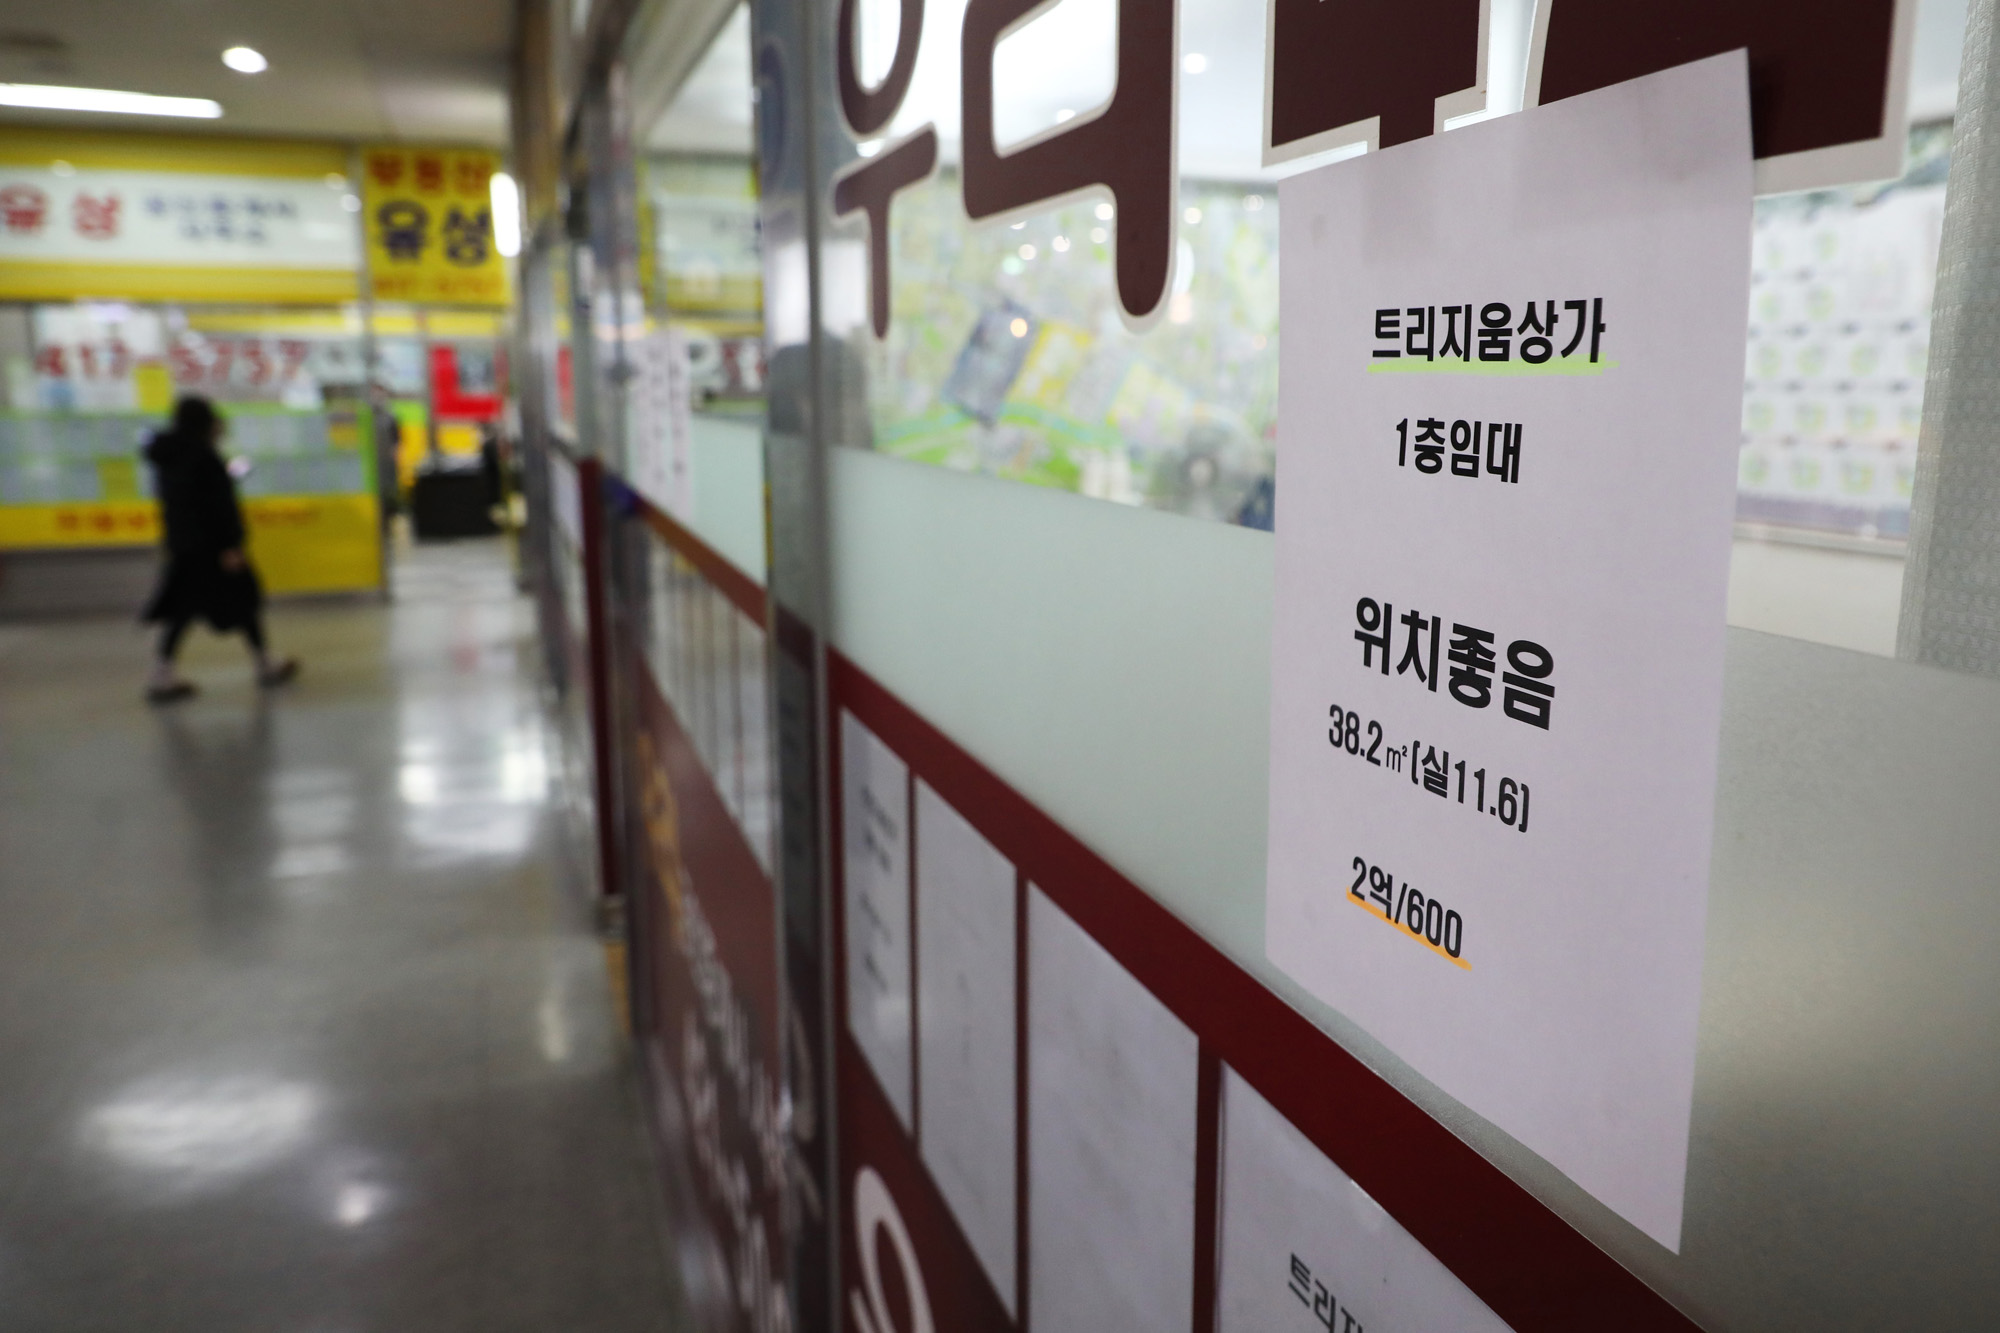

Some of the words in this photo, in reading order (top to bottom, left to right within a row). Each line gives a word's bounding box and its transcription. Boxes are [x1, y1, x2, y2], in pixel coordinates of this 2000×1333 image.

[1372, 297, 1606, 364] 트리지움상가
[1396, 417, 1523, 484] 1층임대
[1354, 597, 1556, 731] 위치좋음
[1351, 856, 1463, 959] 2억/600
[1288, 1252, 1364, 1333] 트리
